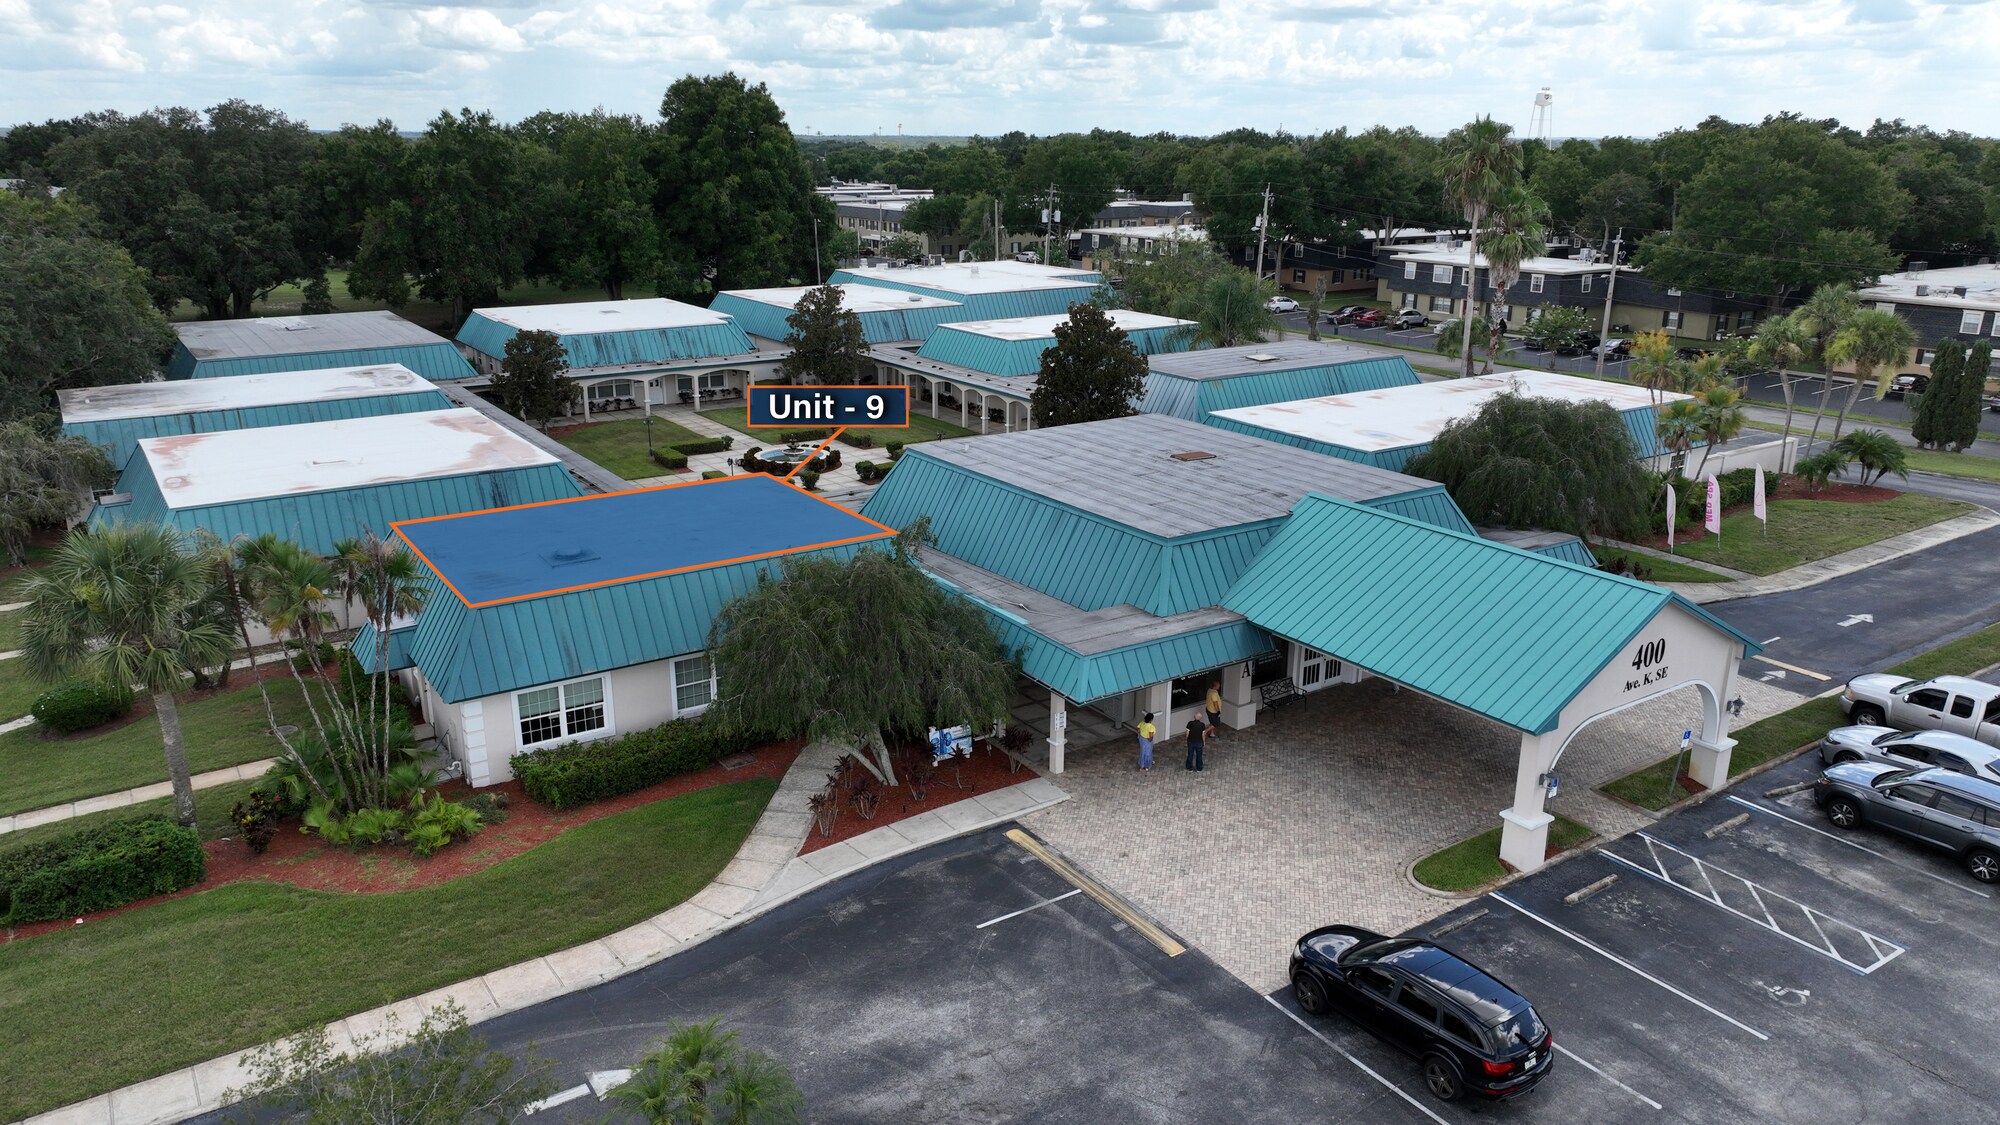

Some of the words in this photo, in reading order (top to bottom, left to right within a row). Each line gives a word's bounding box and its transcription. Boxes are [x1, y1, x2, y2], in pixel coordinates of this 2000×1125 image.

[1632, 638, 1666, 670] 400
[1622, 680, 1641, 693] Ave.
[1643, 672, 1653, 686] K,
[1655, 666, 1669, 681] SE
